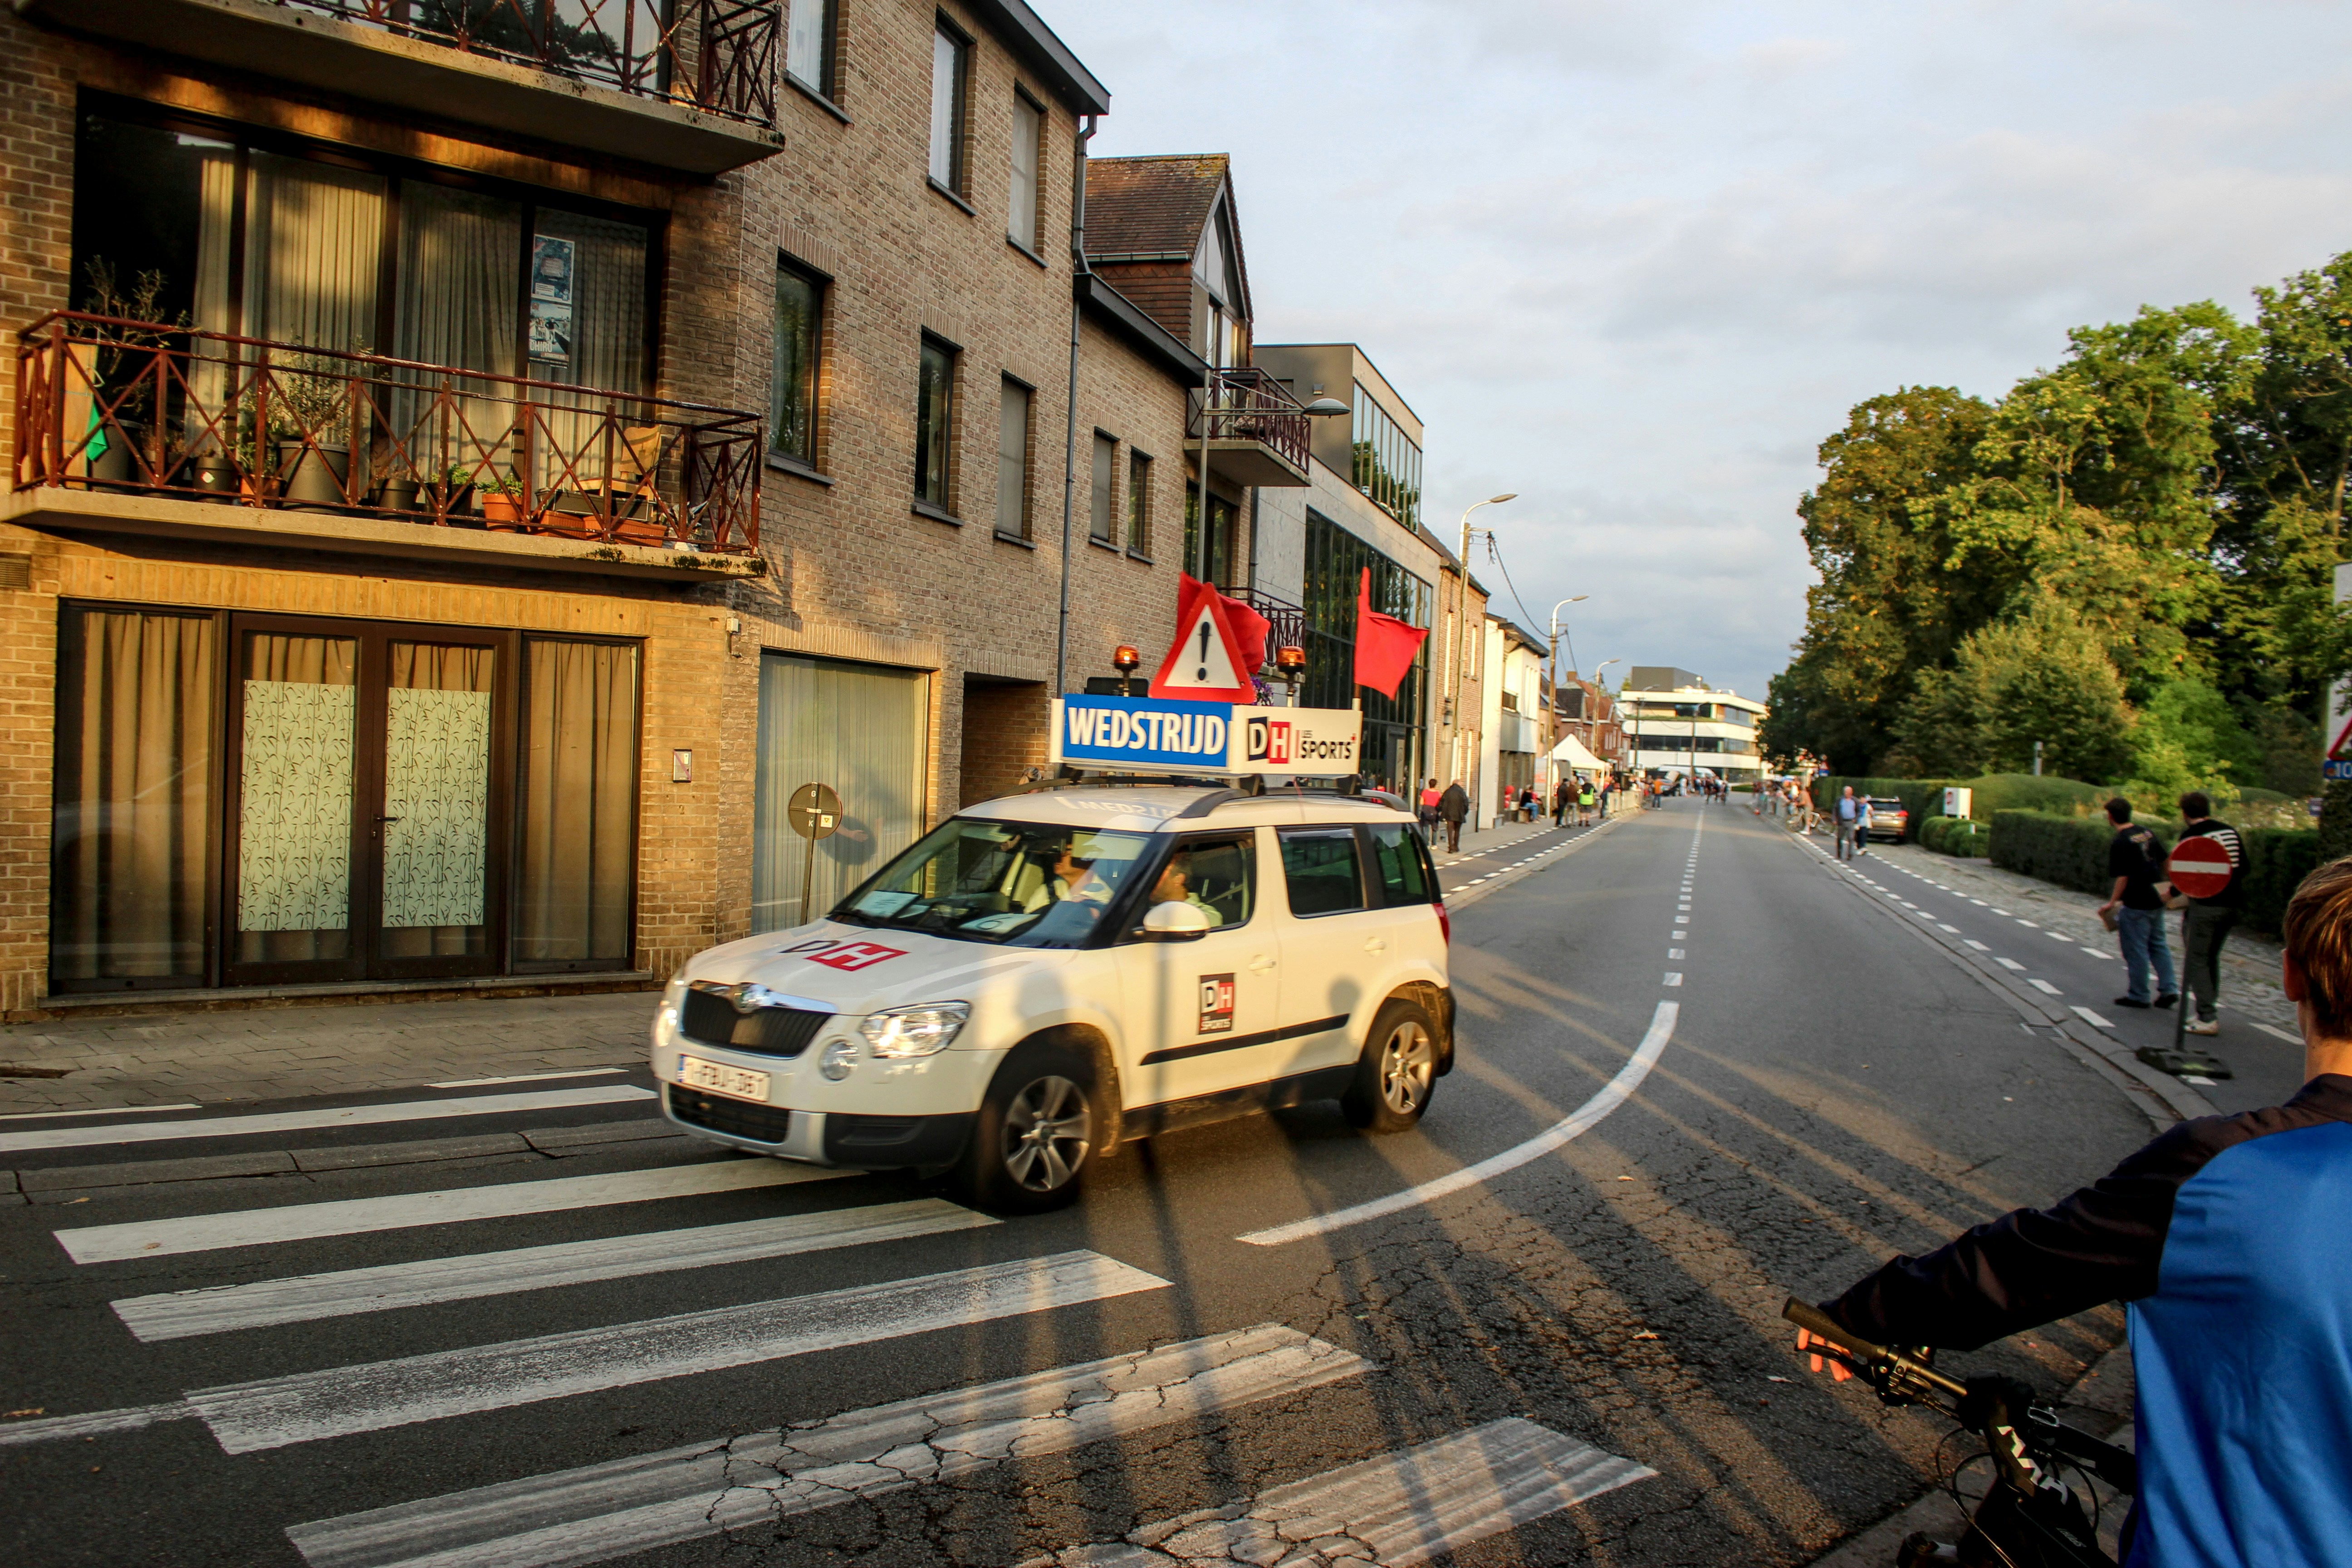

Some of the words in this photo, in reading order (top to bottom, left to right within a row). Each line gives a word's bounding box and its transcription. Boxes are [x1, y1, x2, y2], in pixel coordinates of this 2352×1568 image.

[1068, 706, 1226, 755] WEDSTRIJD
[1248, 720, 1290, 760] DH
[1200, 980, 1233, 1013] DH
